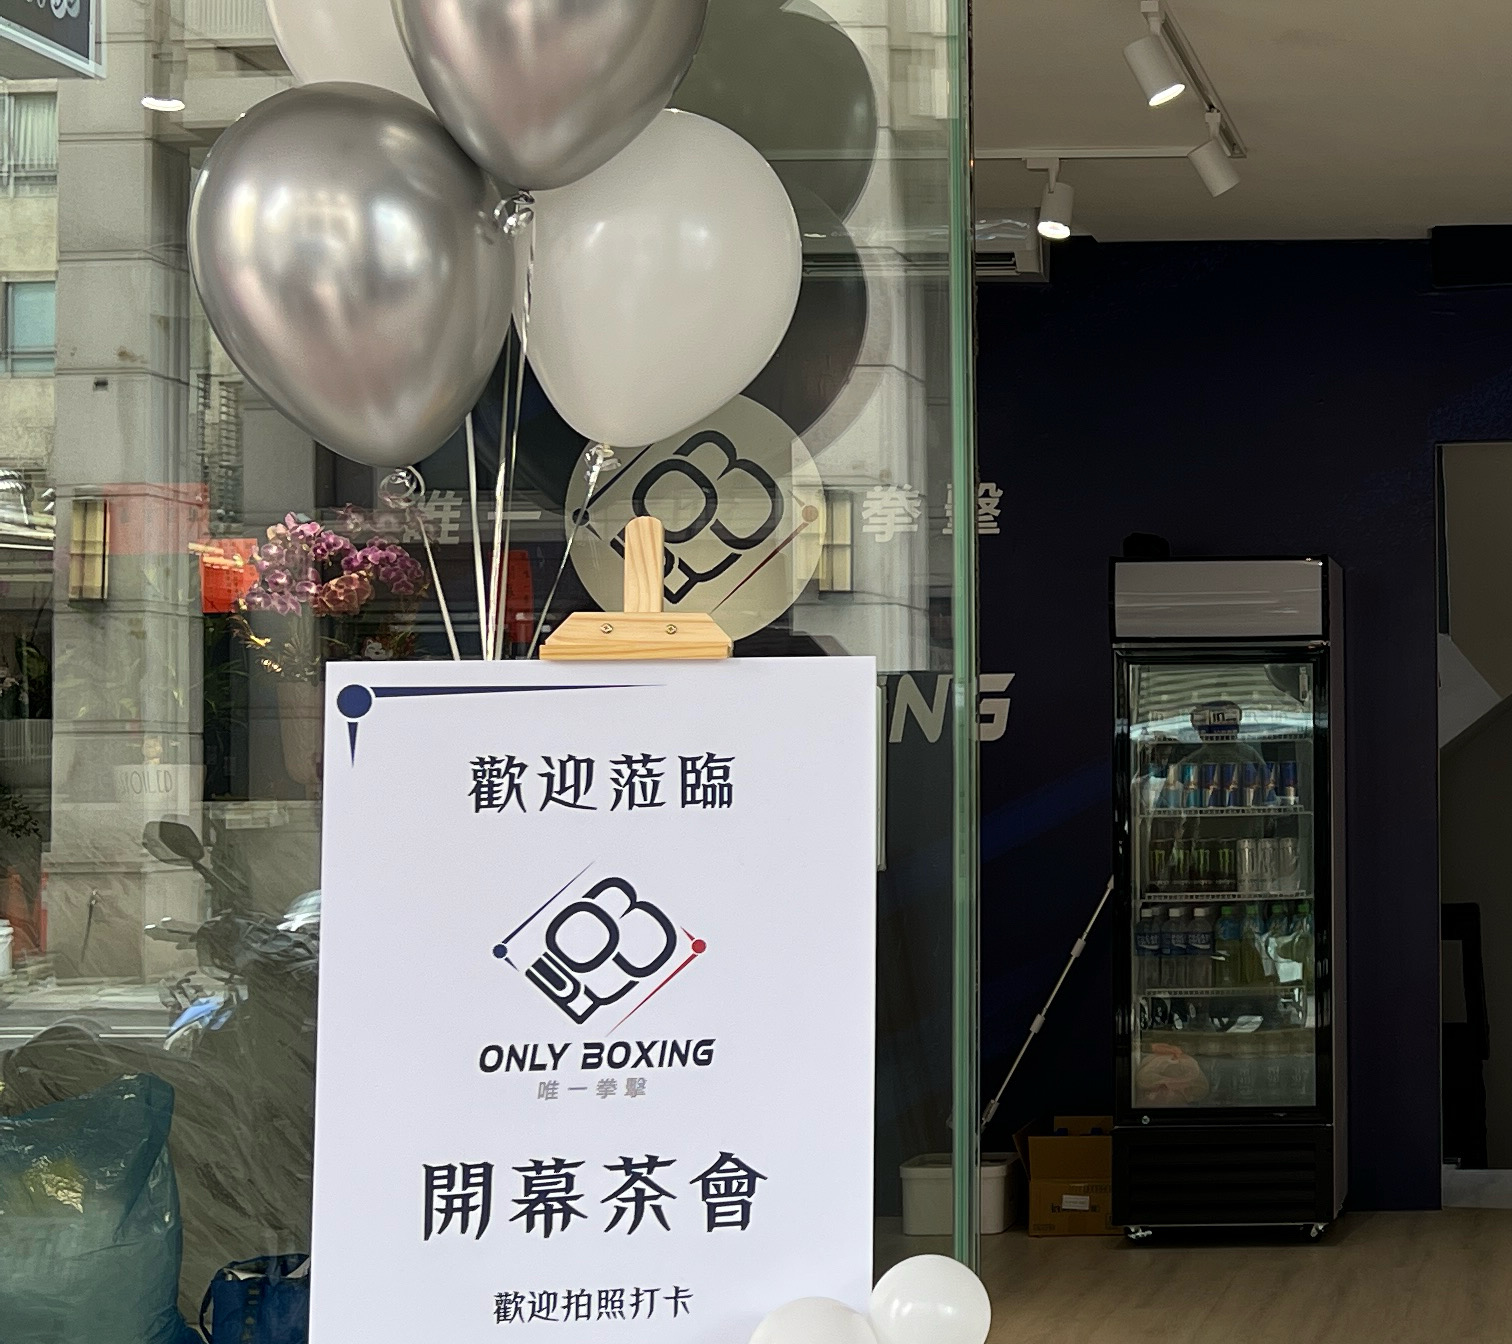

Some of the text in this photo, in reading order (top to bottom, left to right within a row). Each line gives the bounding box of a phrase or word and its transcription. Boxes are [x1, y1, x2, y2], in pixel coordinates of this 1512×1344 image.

[469, 751, 736, 814] 歡迎蒞臨
[479, 1038, 716, 1073] ONLY BOXING
[537, 1077, 648, 1101] 唯一拳擊
[422, 1150, 769, 1242] 開幕茶會
[492, 1287, 695, 1326] 歡迎拍照打卡
